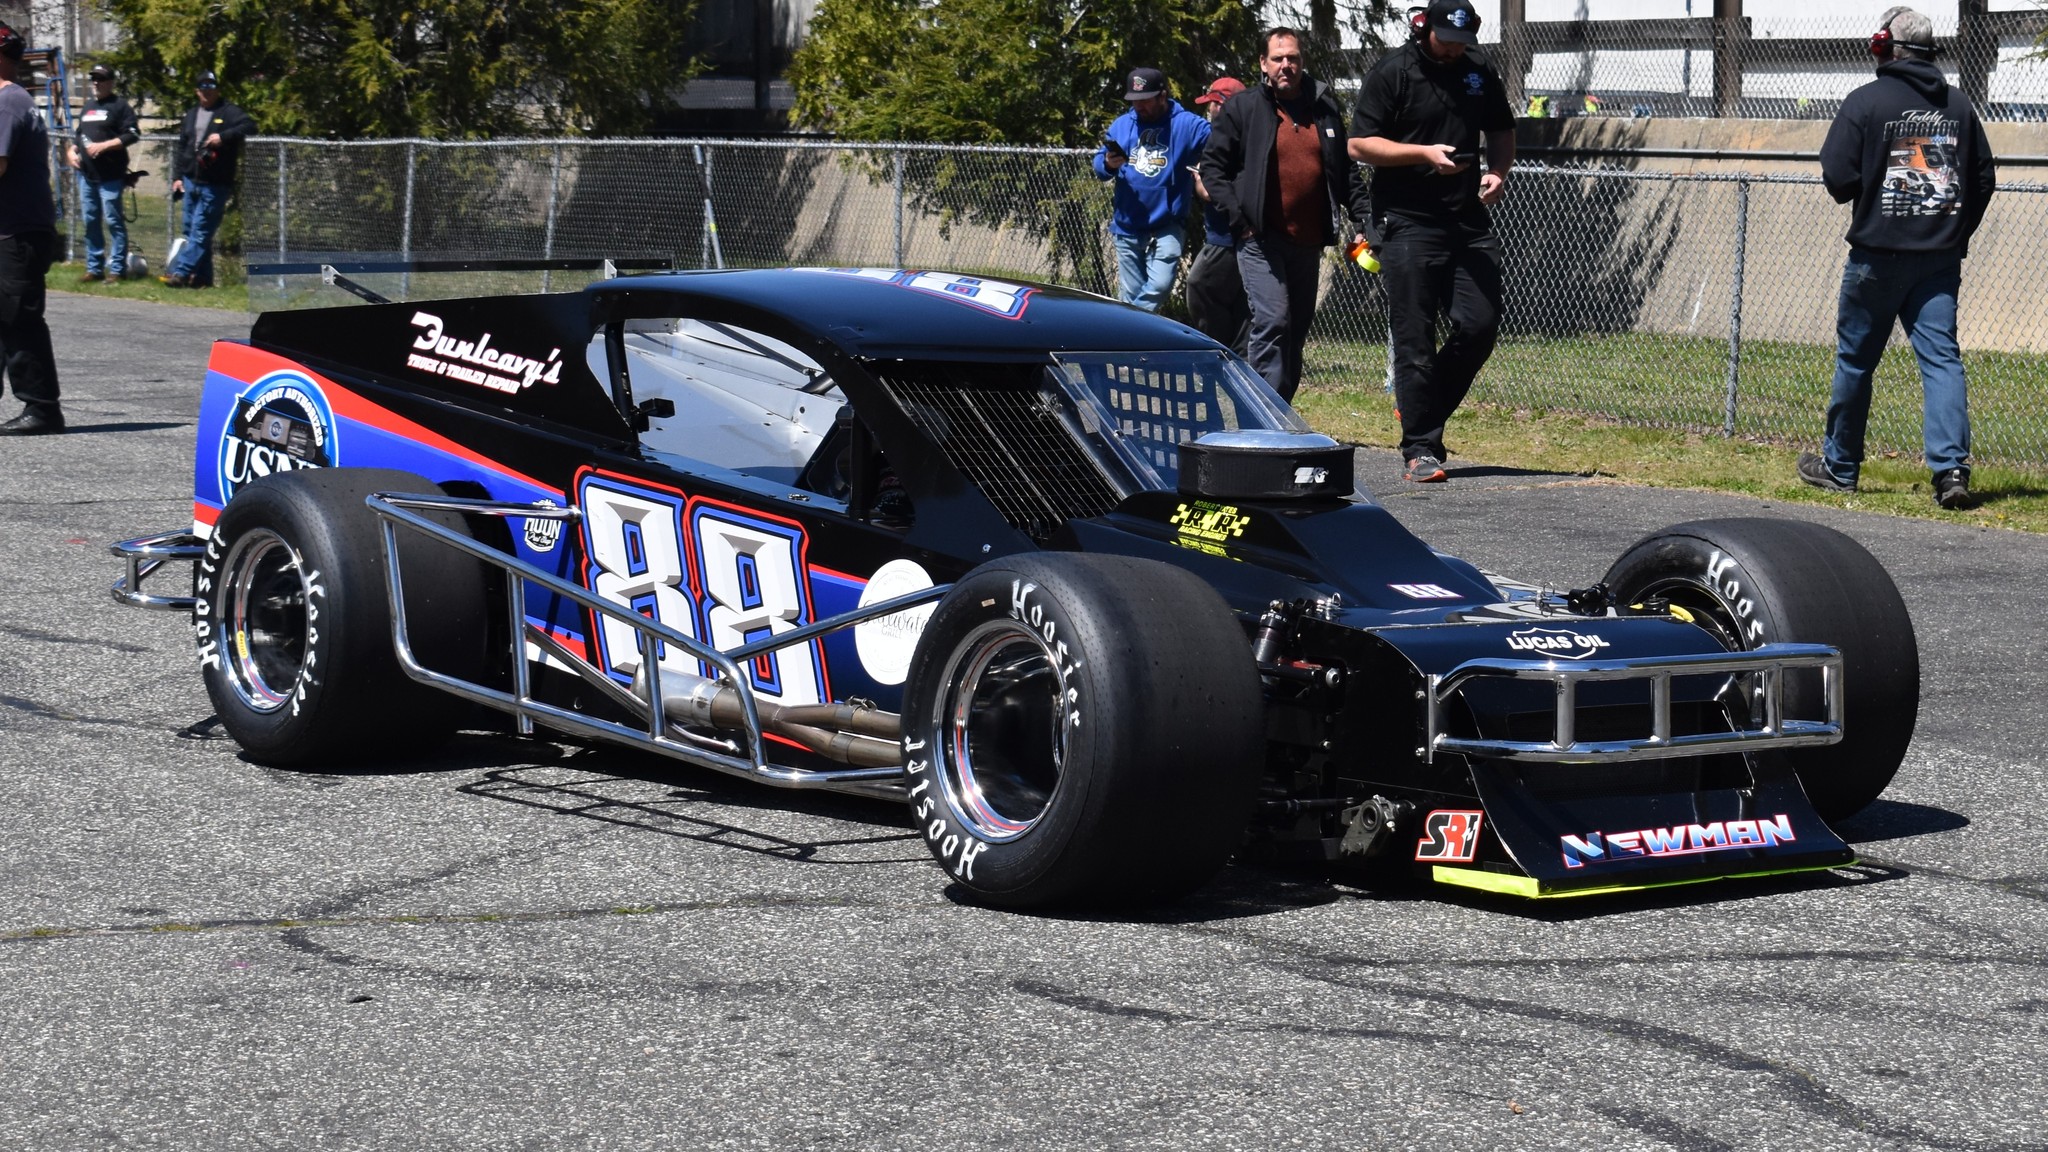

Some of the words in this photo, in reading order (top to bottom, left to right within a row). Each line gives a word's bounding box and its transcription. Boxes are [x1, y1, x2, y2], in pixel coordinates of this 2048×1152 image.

[1902, 110, 1943, 125] Teddy
[407, 353, 440, 373] TRUCK
[446, 363, 487, 385] TRAILER
[483, 374, 521, 394] REPAIR
[411, 311, 563, 388] Dunleavy's
[244, 387, 285, 422] FACTORY
[285, 387, 324, 447] AUTHORIZED
[1193, 500, 1220, 511] ROBERT
[196, 526, 226, 671] Hoosier
[574, 465, 832, 706] 88
[1387, 583, 1464, 600] 88
[1506, 635, 1573, 650] LUCAS
[1574, 634, 1611, 648] OIL
[1700, 551, 1766, 697] Hoos
[1009, 579, 1082, 727] Hoosier
[905, 735, 989, 881] Hoosier
[1418, 812, 1481, 859] SRI
[1561, 814, 1797, 869] NEWMAN
